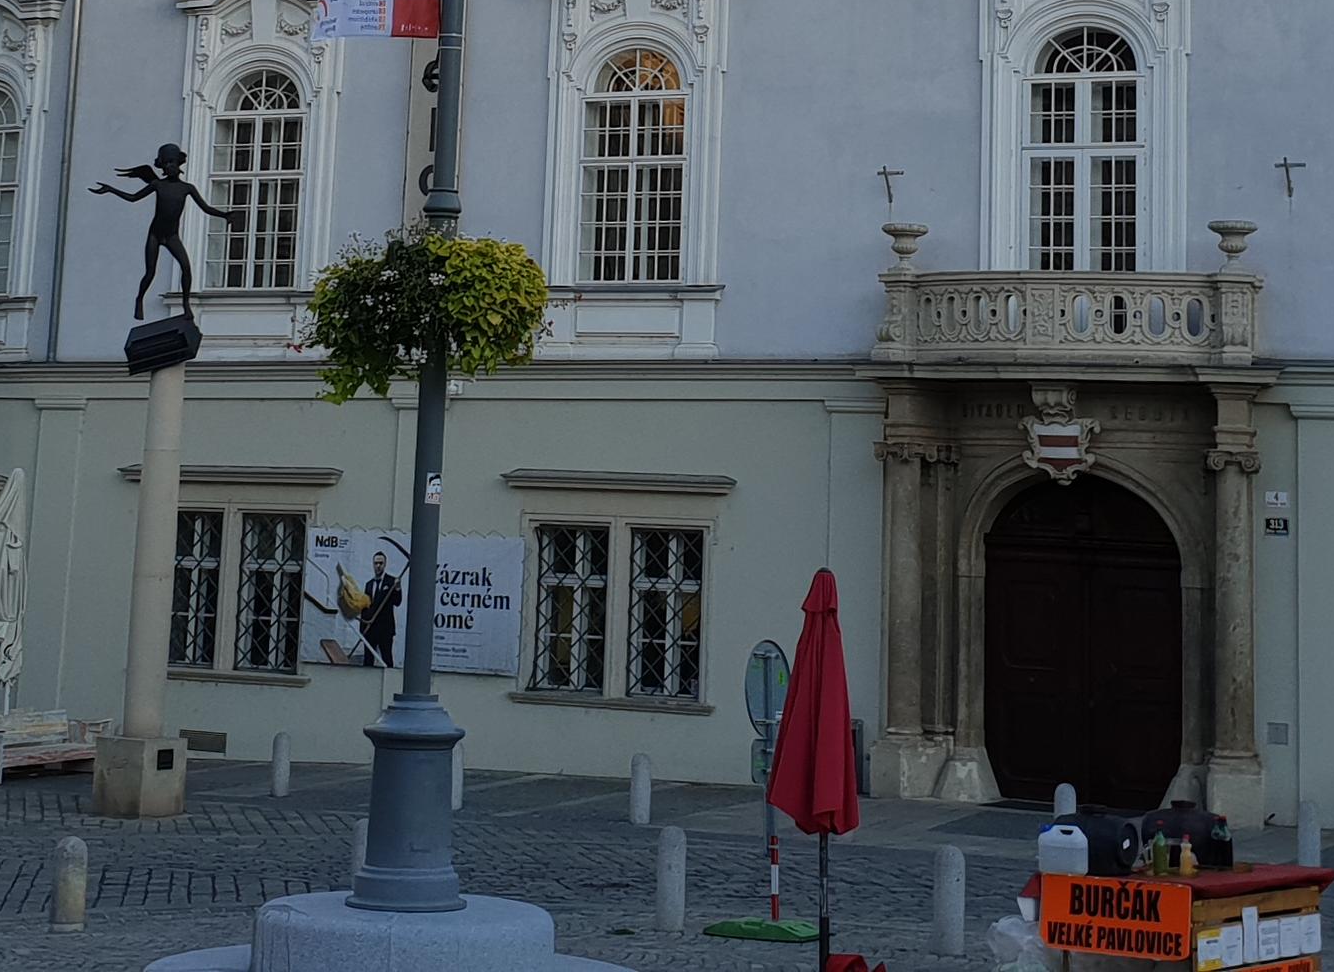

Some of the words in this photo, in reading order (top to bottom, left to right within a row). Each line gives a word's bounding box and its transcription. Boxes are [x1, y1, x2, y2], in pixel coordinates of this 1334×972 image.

[315, 535, 338, 548] NdB
[434, 563, 493, 587] ázrak
[440, 587, 511, 610] černém
[434, 610, 475, 629] omě
[1069, 881, 1162, 923] BURČÁK
[1047, 919, 1093, 948] VELKÉ
[1096, 928, 1184, 958] PAVLOVICE
